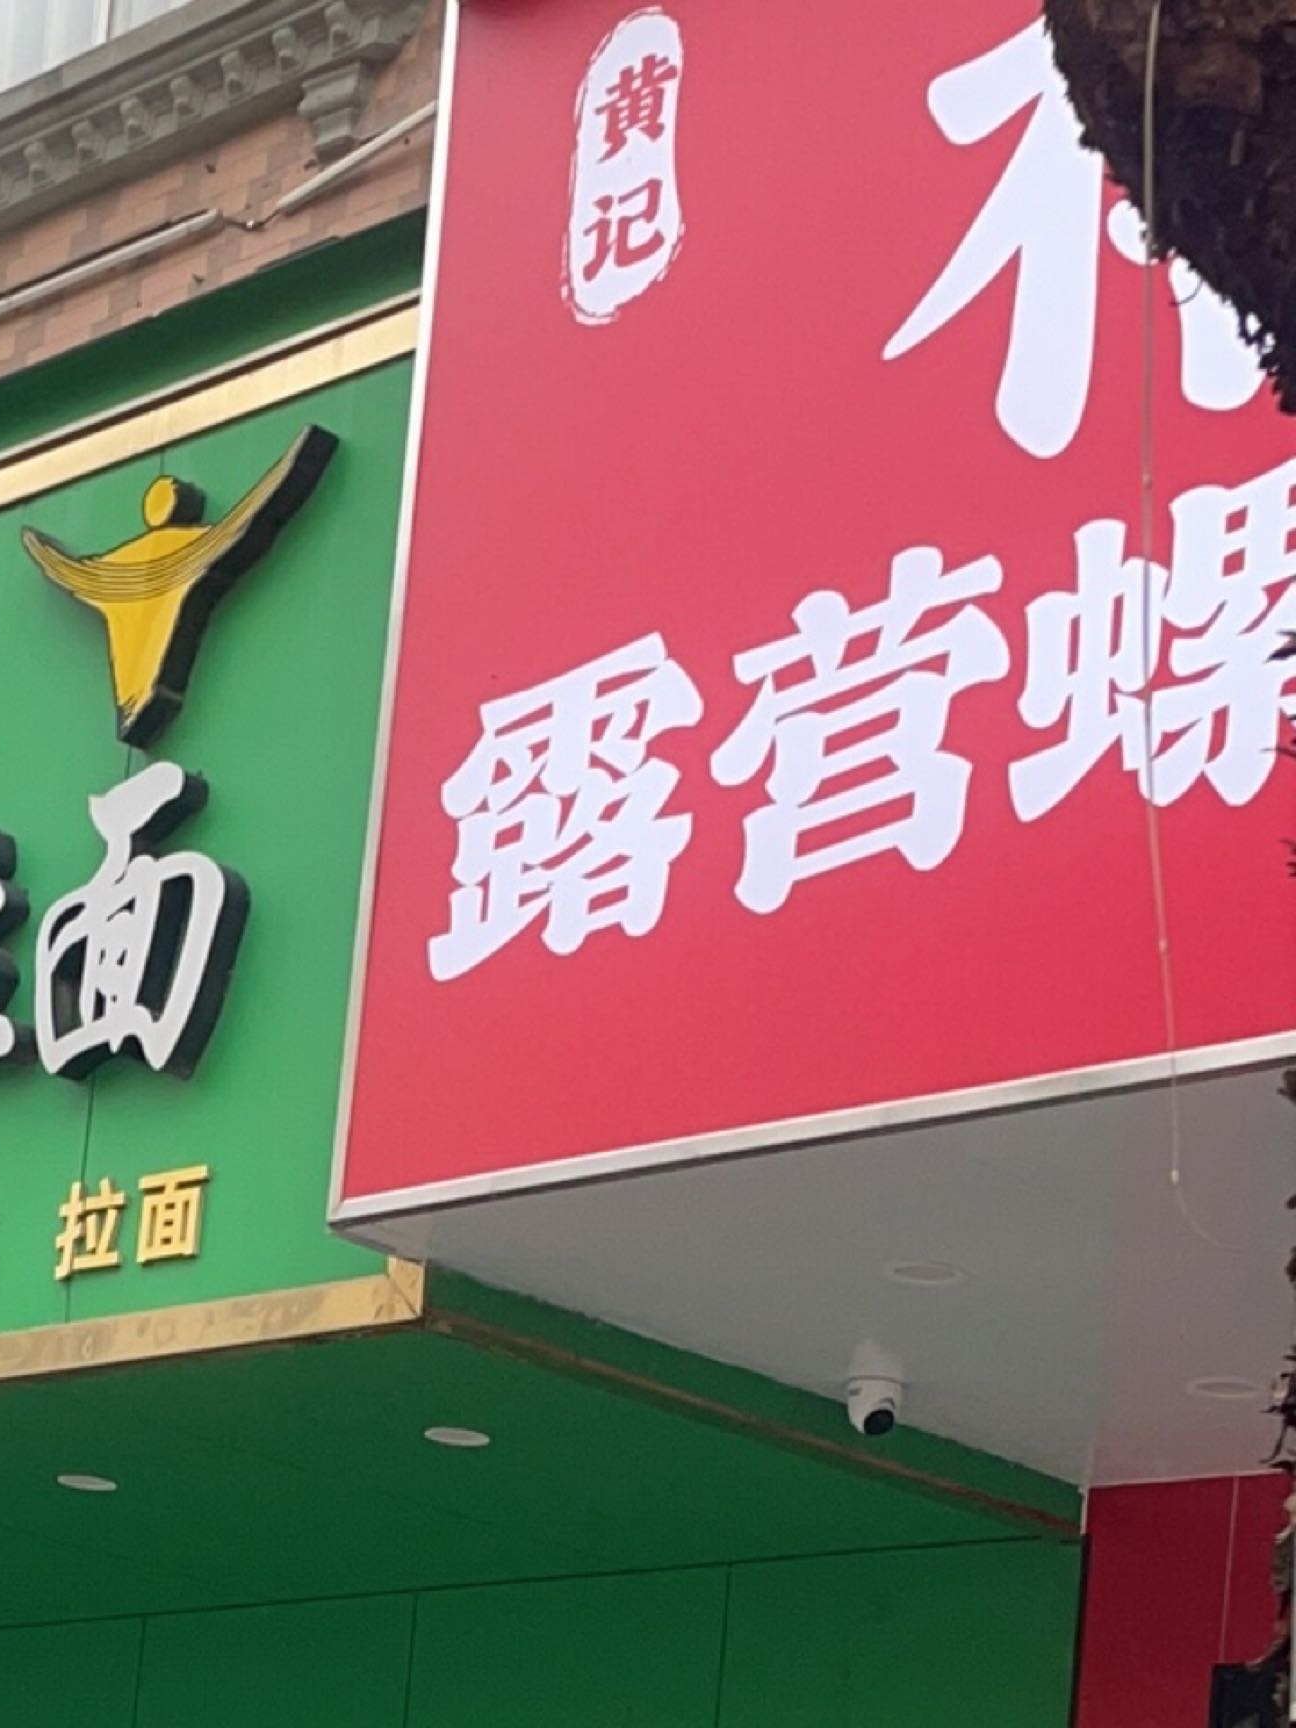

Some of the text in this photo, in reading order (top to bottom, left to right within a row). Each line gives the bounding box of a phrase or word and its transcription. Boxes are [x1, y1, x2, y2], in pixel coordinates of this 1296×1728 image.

[581, 55, 678, 284] 黄记
[427, 457, 1296, 982] 露营螺
[54, 1164, 210, 1281] 拉面
